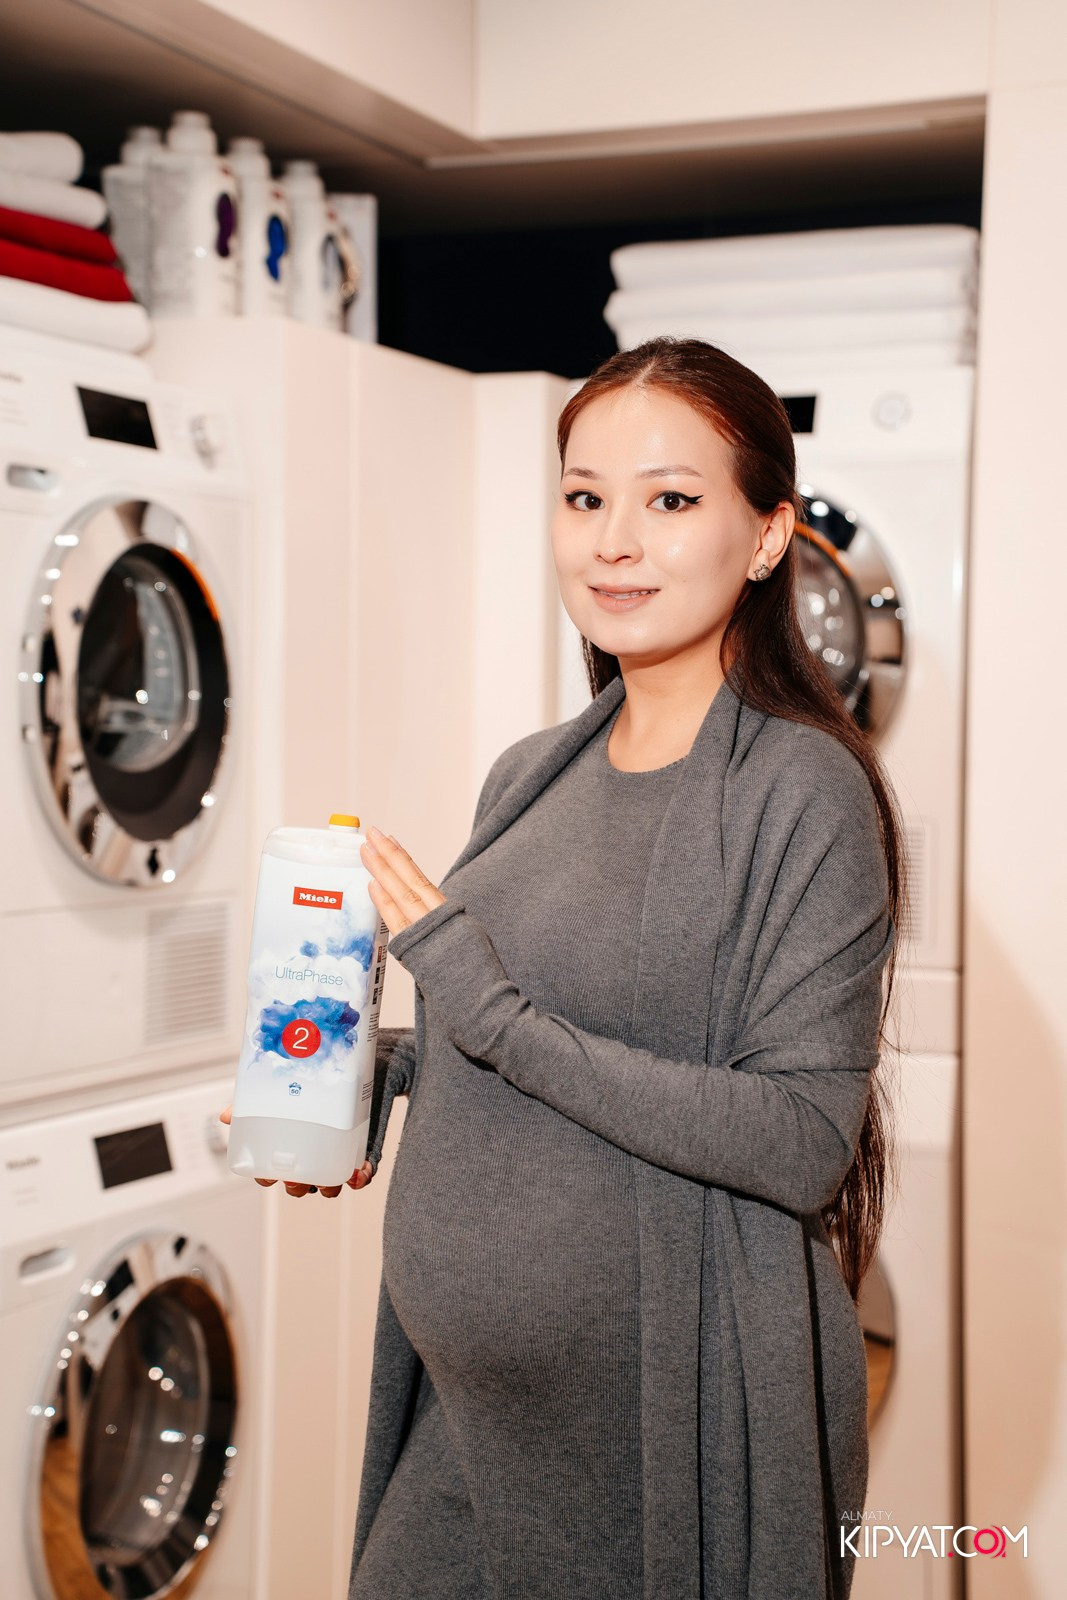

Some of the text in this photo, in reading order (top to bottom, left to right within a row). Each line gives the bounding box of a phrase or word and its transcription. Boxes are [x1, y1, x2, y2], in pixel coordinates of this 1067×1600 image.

[298, 892, 337, 904] Miele
[275, 965, 344, 986] UltraPhase
[292, 1027, 310, 1050] 2
